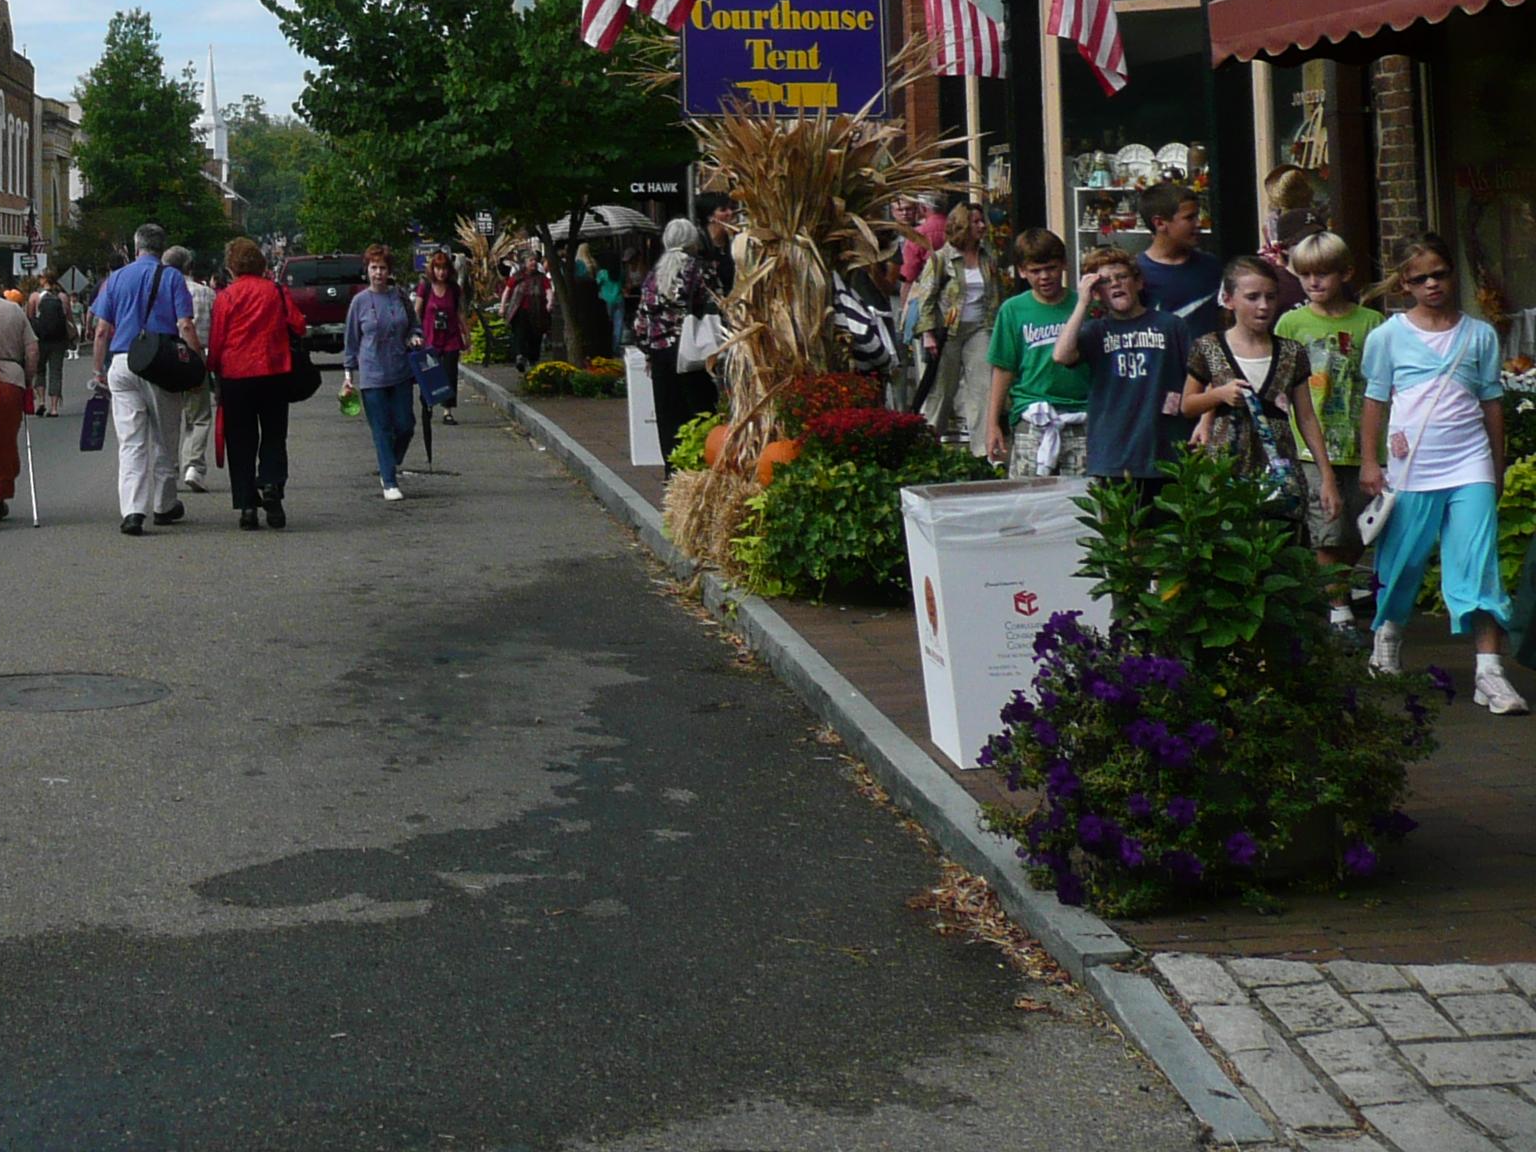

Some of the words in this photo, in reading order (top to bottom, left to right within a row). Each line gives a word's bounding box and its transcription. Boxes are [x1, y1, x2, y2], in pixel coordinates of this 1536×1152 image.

[745, 38, 822, 71] Tent
[648, 182, 678, 193] HAWK
[1118, 352, 1147, 379] 892
